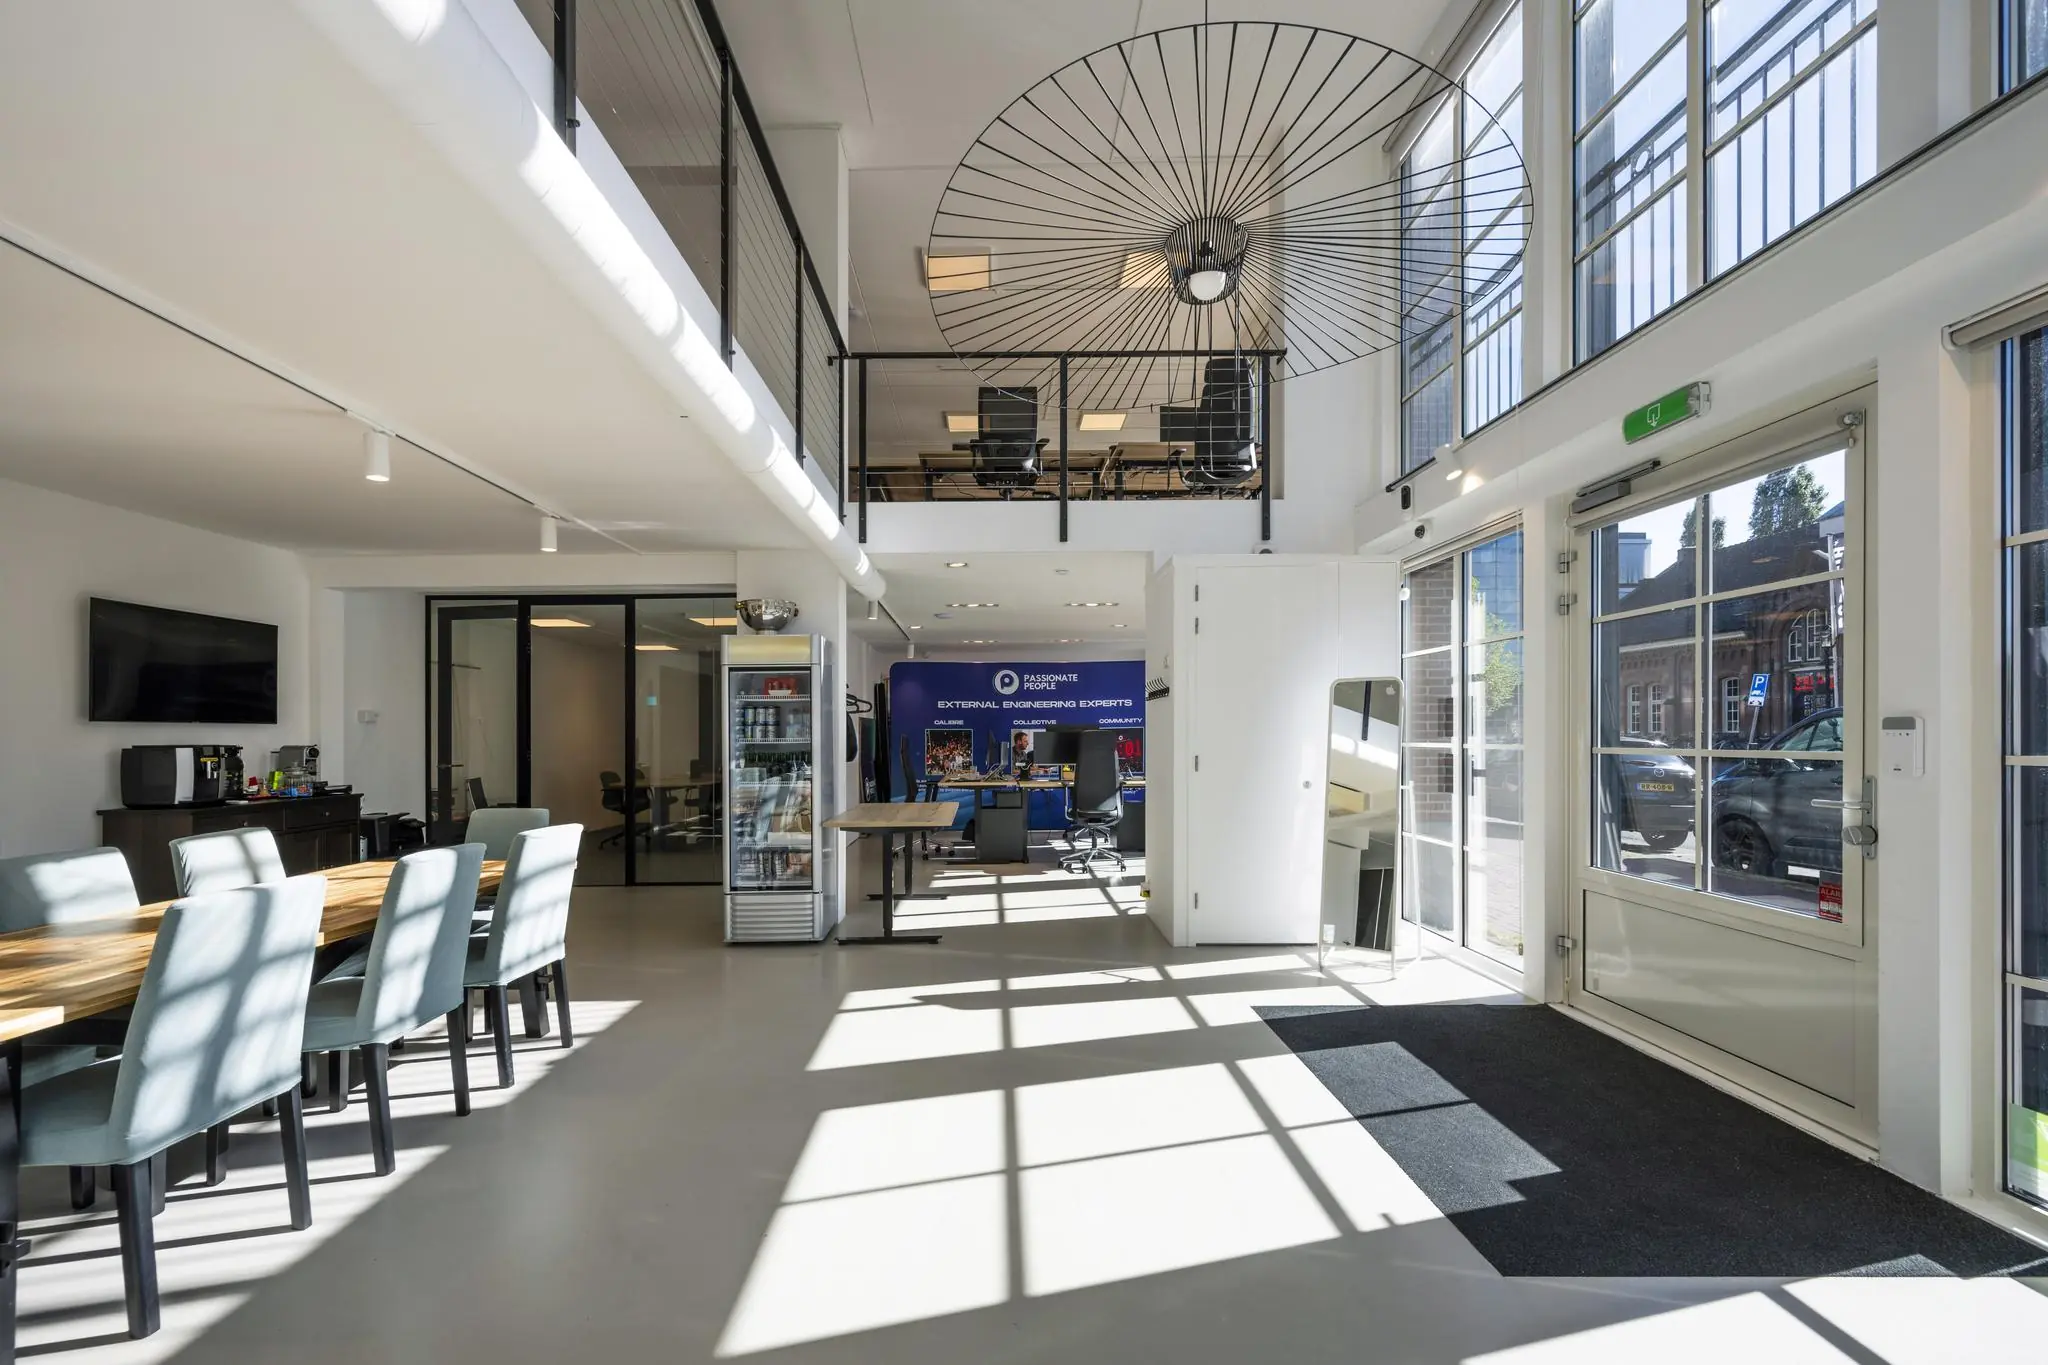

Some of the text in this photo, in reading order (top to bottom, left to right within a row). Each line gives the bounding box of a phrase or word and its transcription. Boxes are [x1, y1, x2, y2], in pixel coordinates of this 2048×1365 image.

[1024, 674, 1078, 682] PASSIONATE
[1755, 676, 1764, 688] P
[1024, 682, 1056, 690] PEOPLE
[937, 699, 1132, 709] EXTERNAL ENGINEERING EXPERTS
